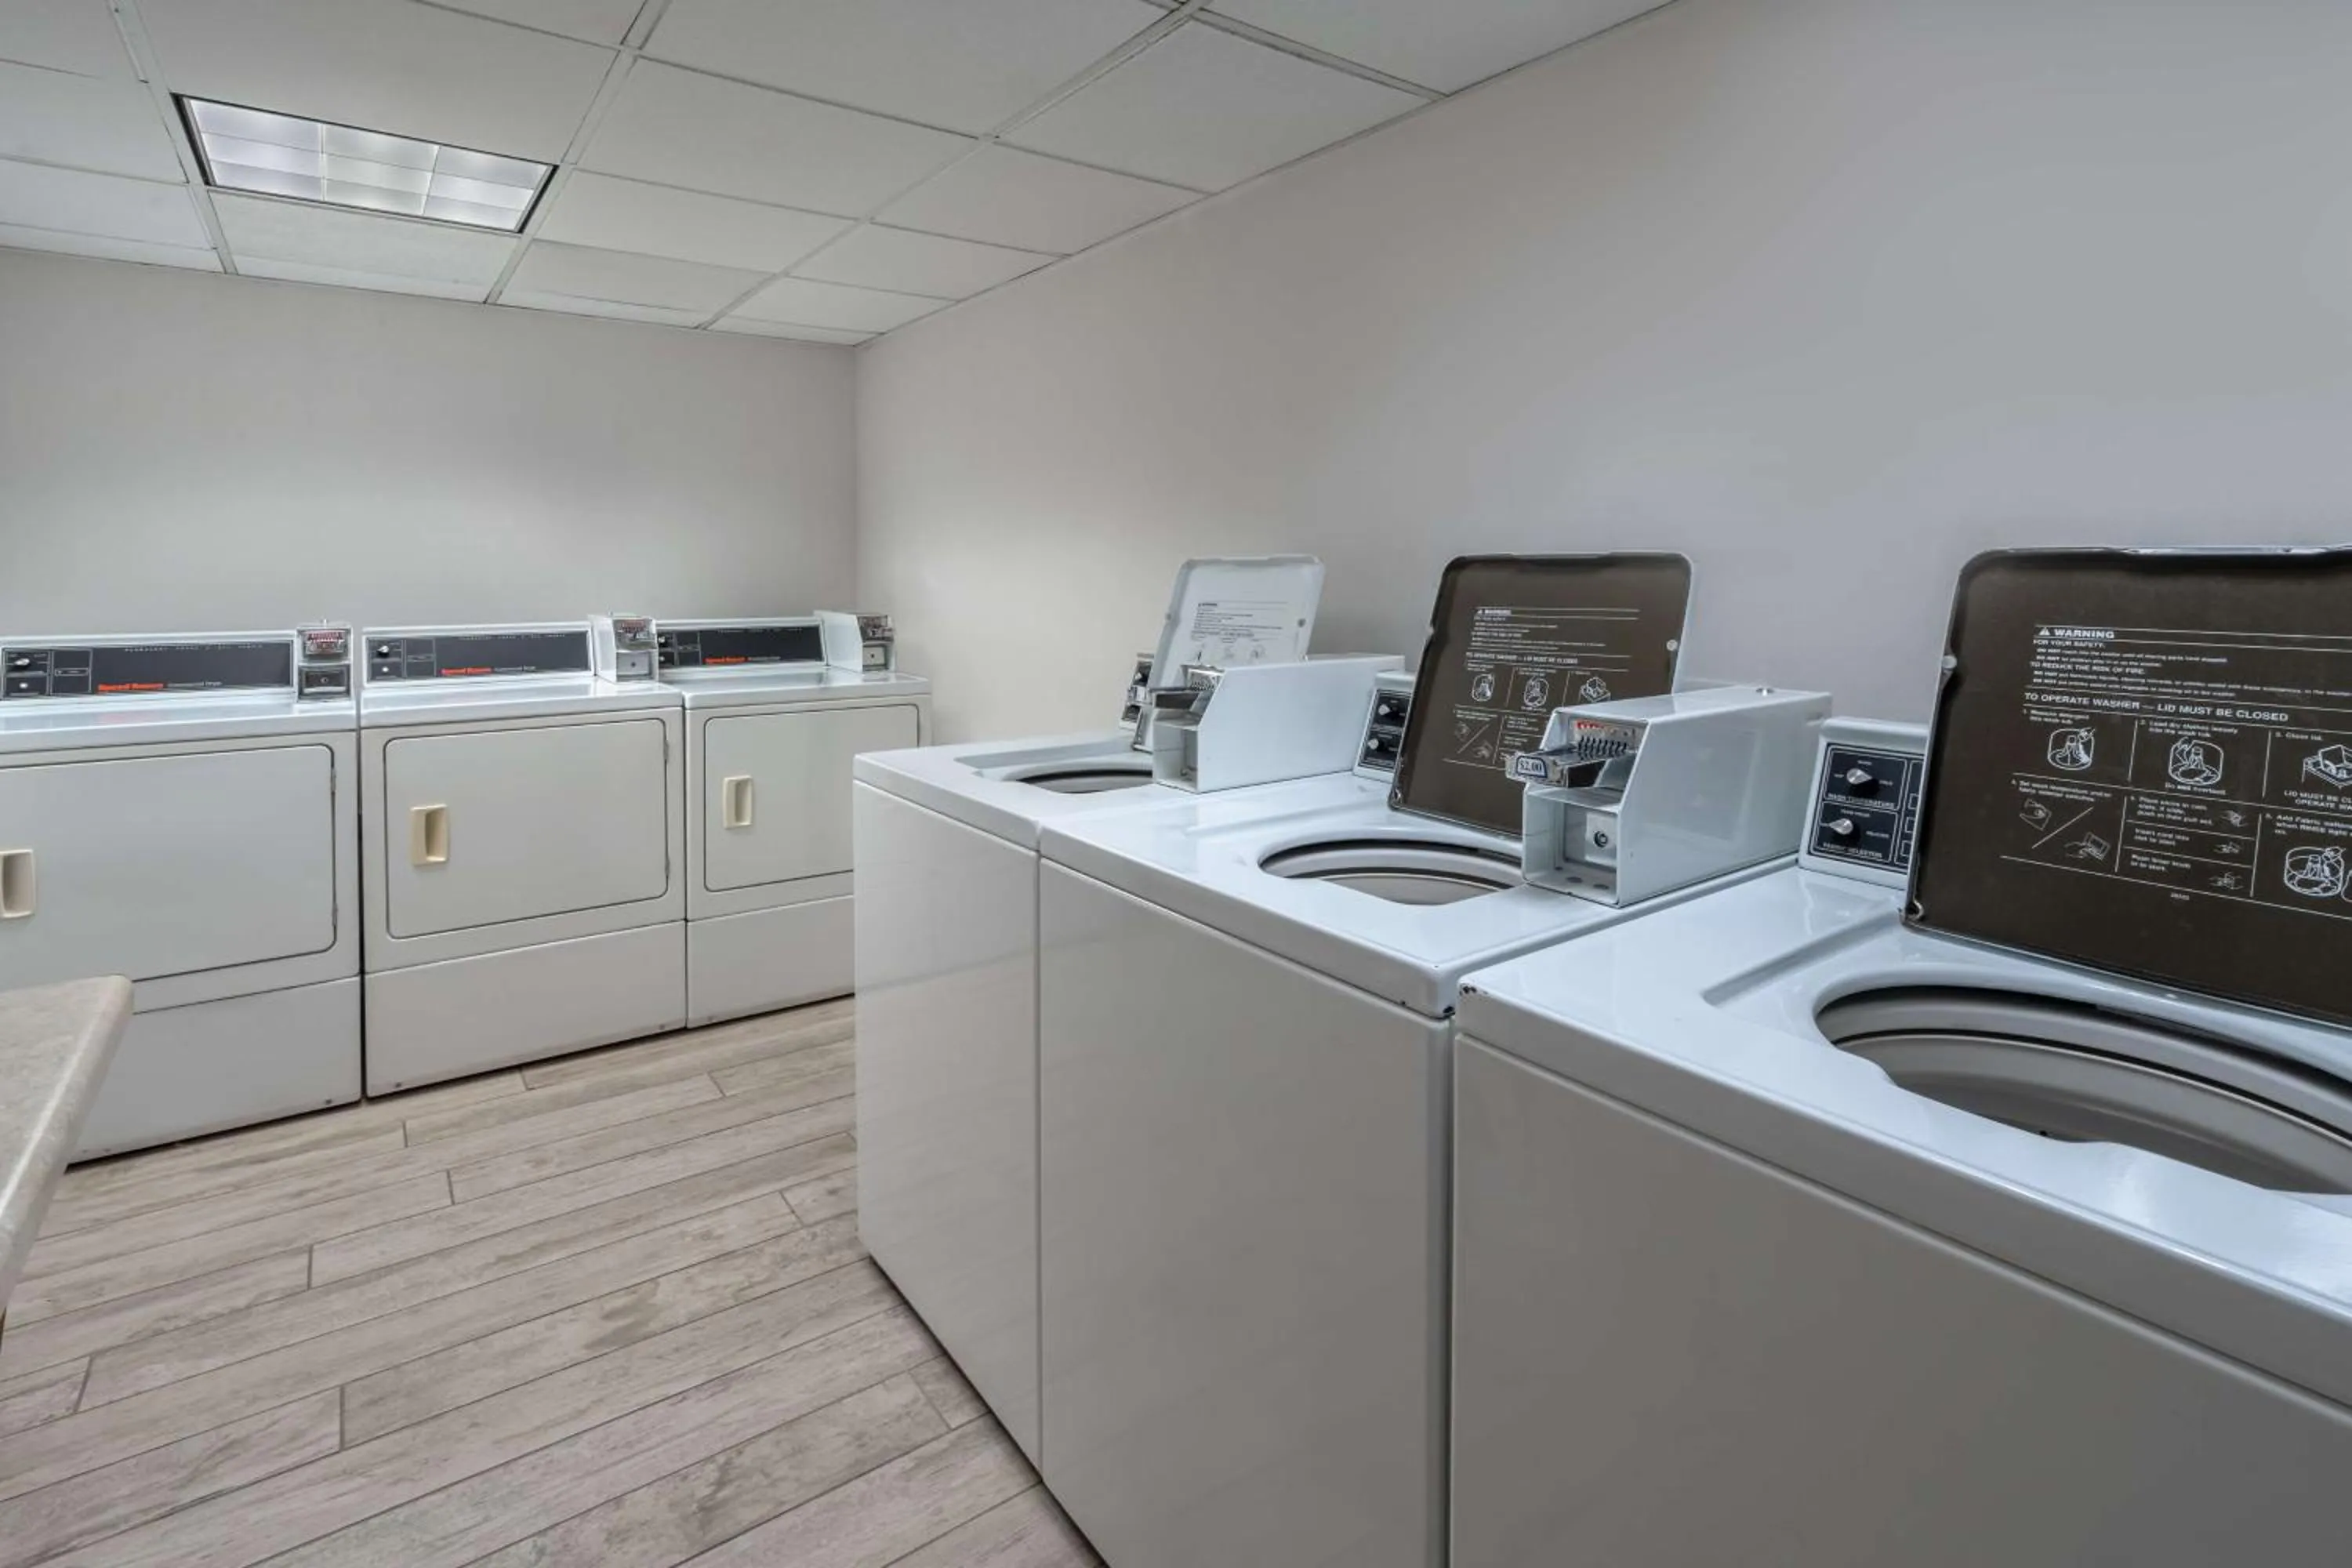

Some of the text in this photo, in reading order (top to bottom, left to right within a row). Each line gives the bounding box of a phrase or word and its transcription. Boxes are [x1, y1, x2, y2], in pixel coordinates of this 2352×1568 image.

[2054, 629, 2114, 639] WARNING
[2041, 693, 2090, 705] OPERATE
[2092, 699, 2140, 710] WASHER
[2158, 703, 2176, 712] LID
[2179, 705, 2212, 716] MUST
[2216, 708, 2233, 717] BE
[2236, 709, 2288, 721] CLOSED
[2284, 789, 2298, 797] LID
[2299, 791, 2324, 800] MUST
